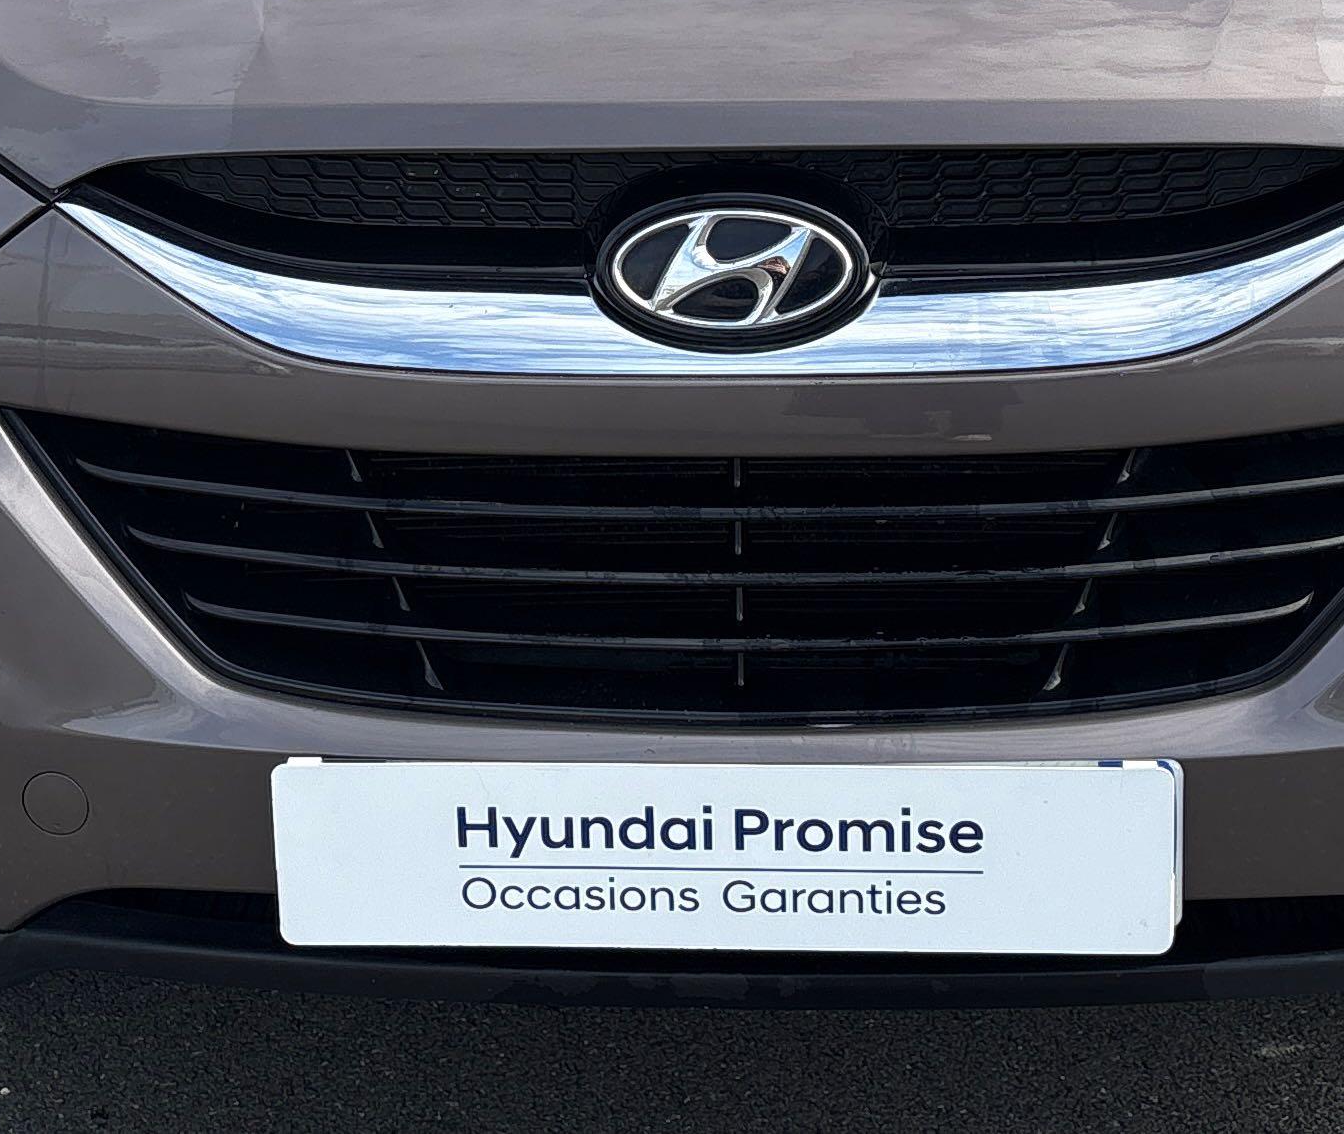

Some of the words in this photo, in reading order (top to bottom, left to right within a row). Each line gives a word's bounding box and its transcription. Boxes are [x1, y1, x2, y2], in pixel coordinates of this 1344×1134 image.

[456, 804, 714, 859] Hyundai
[733, 807, 984, 854] Promise
[461, 876, 701, 912] Occasions
[721, 879, 947, 916] Garanties
